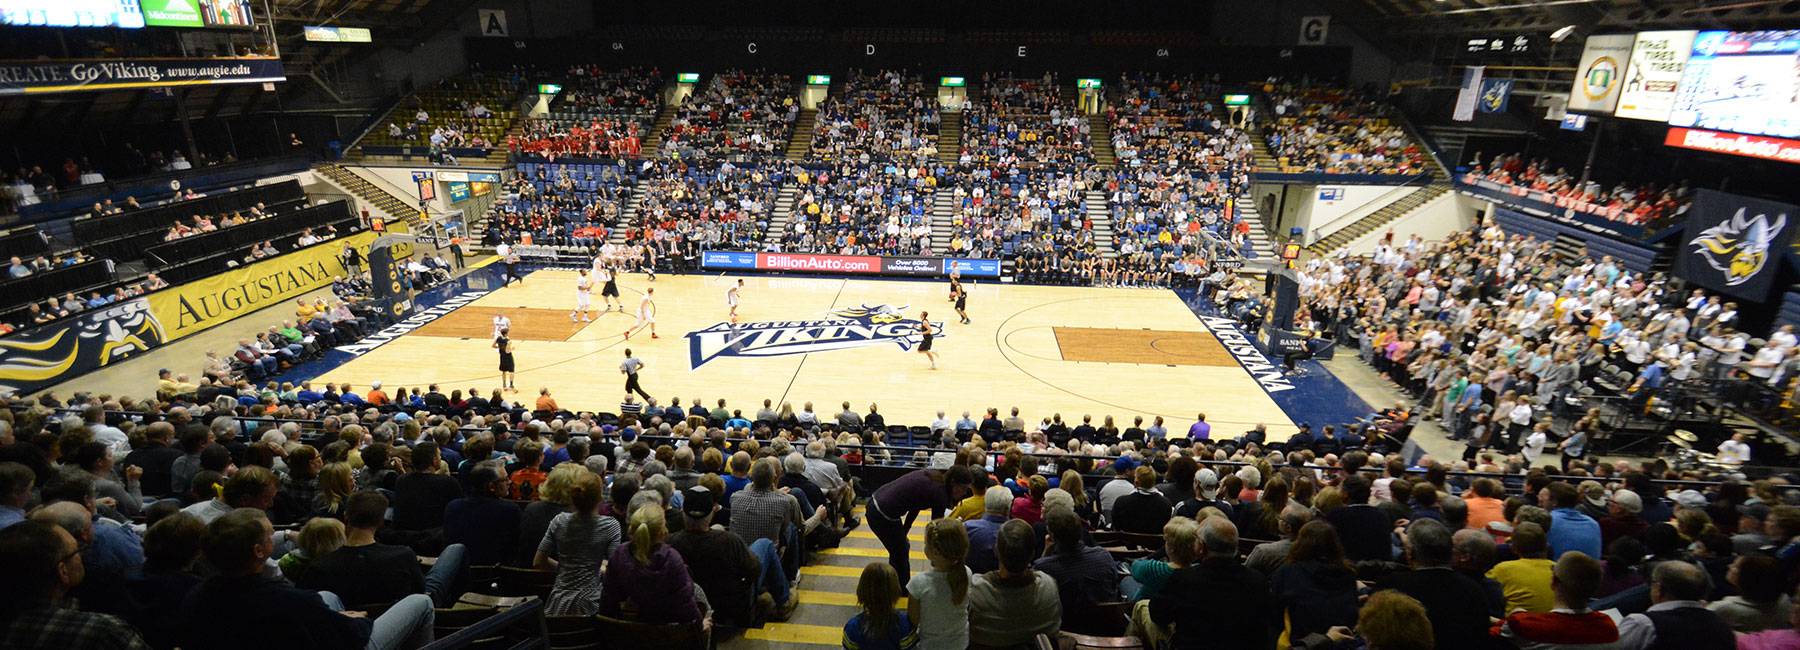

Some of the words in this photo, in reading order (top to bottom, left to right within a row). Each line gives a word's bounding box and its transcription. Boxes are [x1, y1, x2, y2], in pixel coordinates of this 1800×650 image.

[486, 13, 504, 33] A
[1305, 19, 1323, 42] G
[748, 43, 756, 54] C
[866, 45, 875, 55] D
[1018, 46, 1026, 57] E
[1157, 49, 1169, 57] GA
[71, 63, 98, 81] Go
[101, 63, 164, 81] Viking.
[167, 64, 251, 79] www.augie.edu
[767, 255, 869, 271] BillionAuto.com
[176, 260, 331, 330] AUGUSTANA
[334, 290, 491, 356] AUGUSTANA
[706, 319, 864, 332] AUGUSTANA
[685, 321, 945, 370] VIKINGS
[1200, 315, 1296, 393] AUGUSTANA
